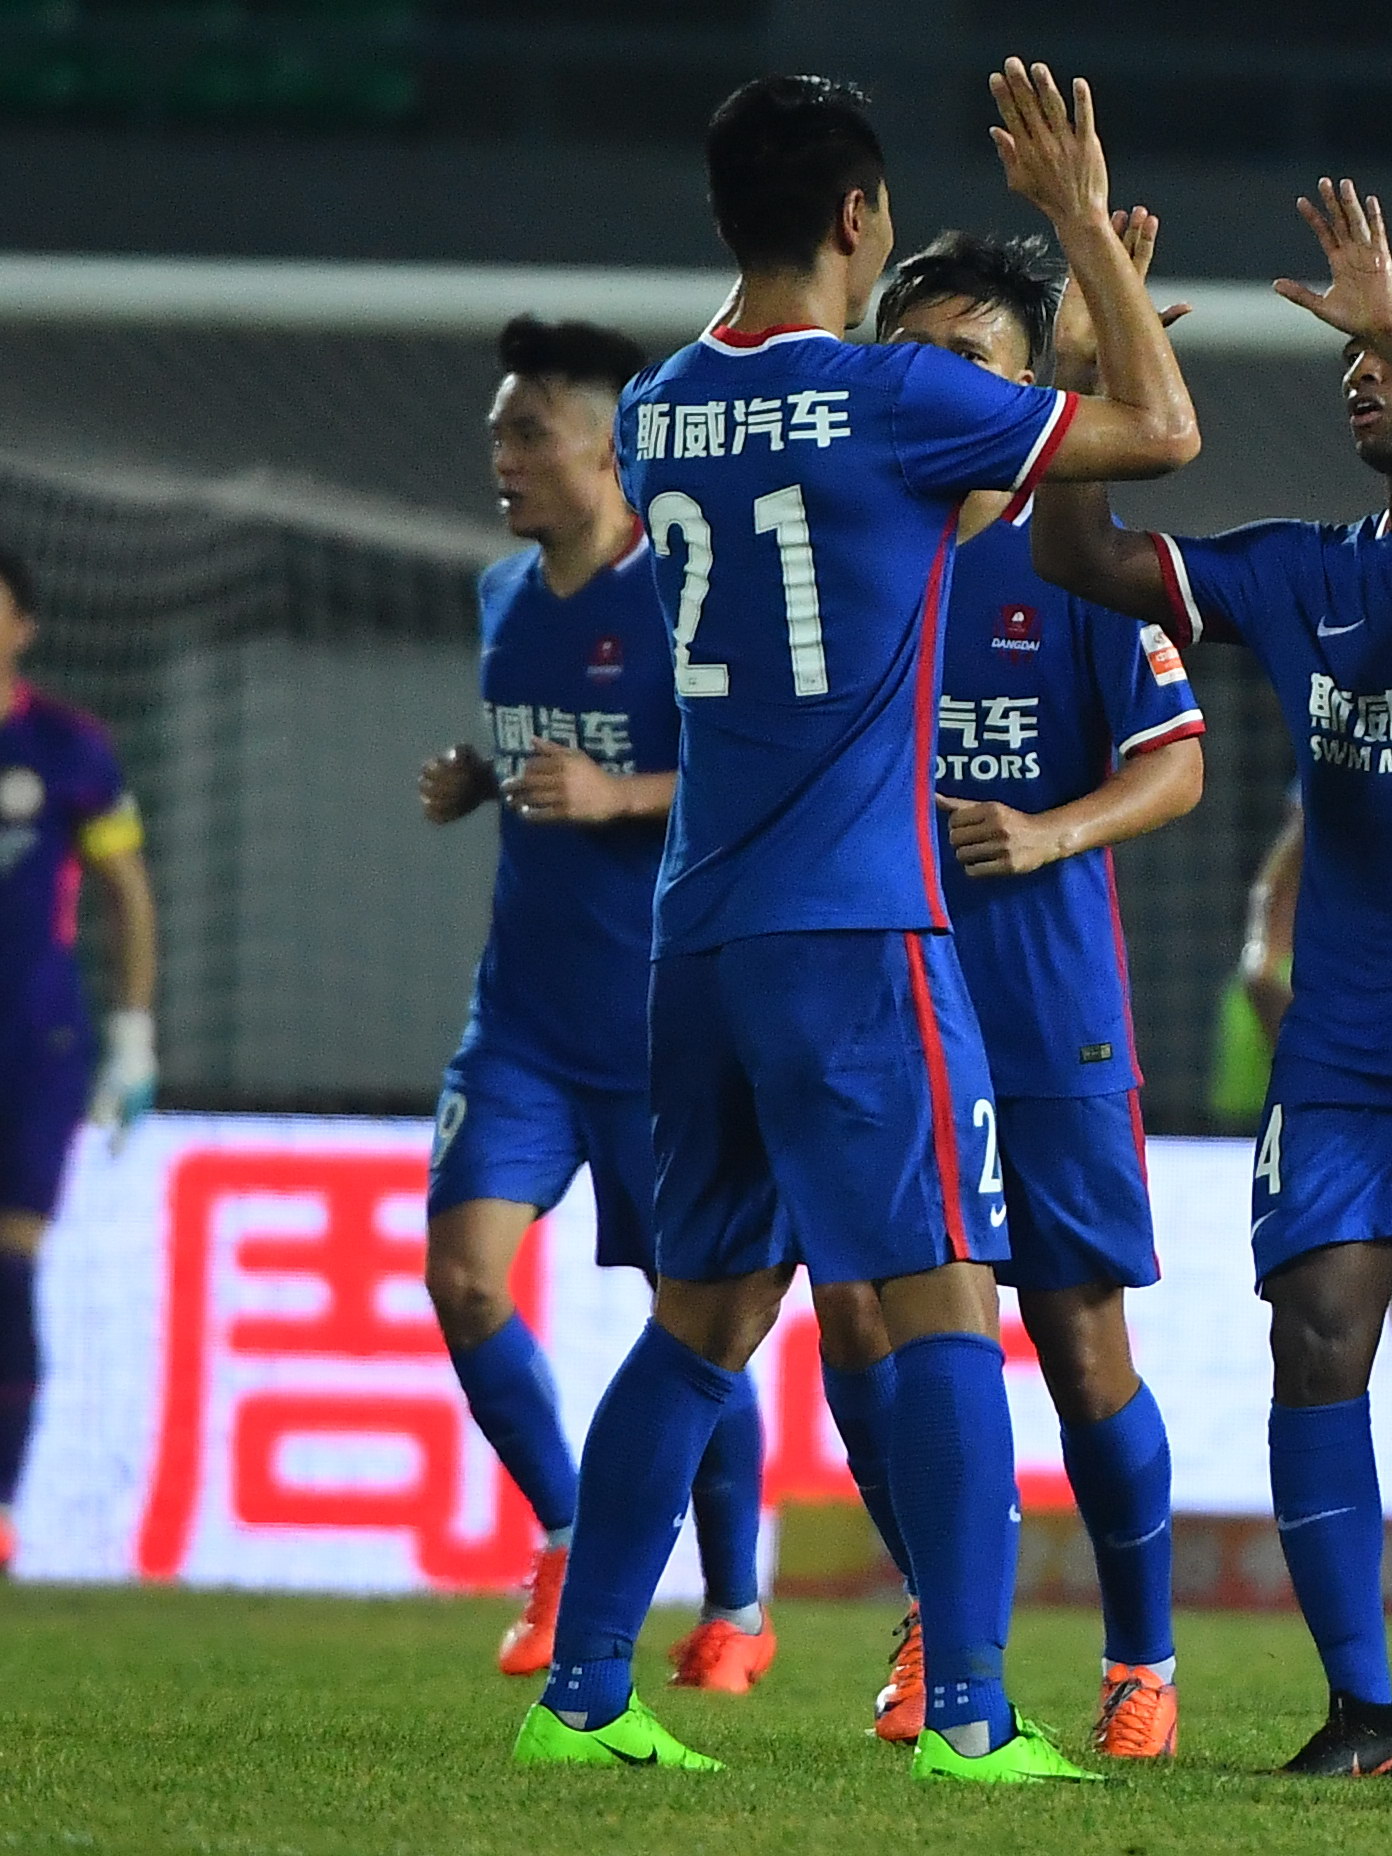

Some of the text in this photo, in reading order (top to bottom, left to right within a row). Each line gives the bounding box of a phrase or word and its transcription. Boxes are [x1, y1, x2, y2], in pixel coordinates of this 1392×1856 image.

[636, 390, 851, 461] 斯威汽车
[648, 484, 829, 698] 21
[990, 637, 1041, 651] DANGDAI
[1310, 735, 1371, 772] SWM
[1255, 1103, 1282, 1194] 4
